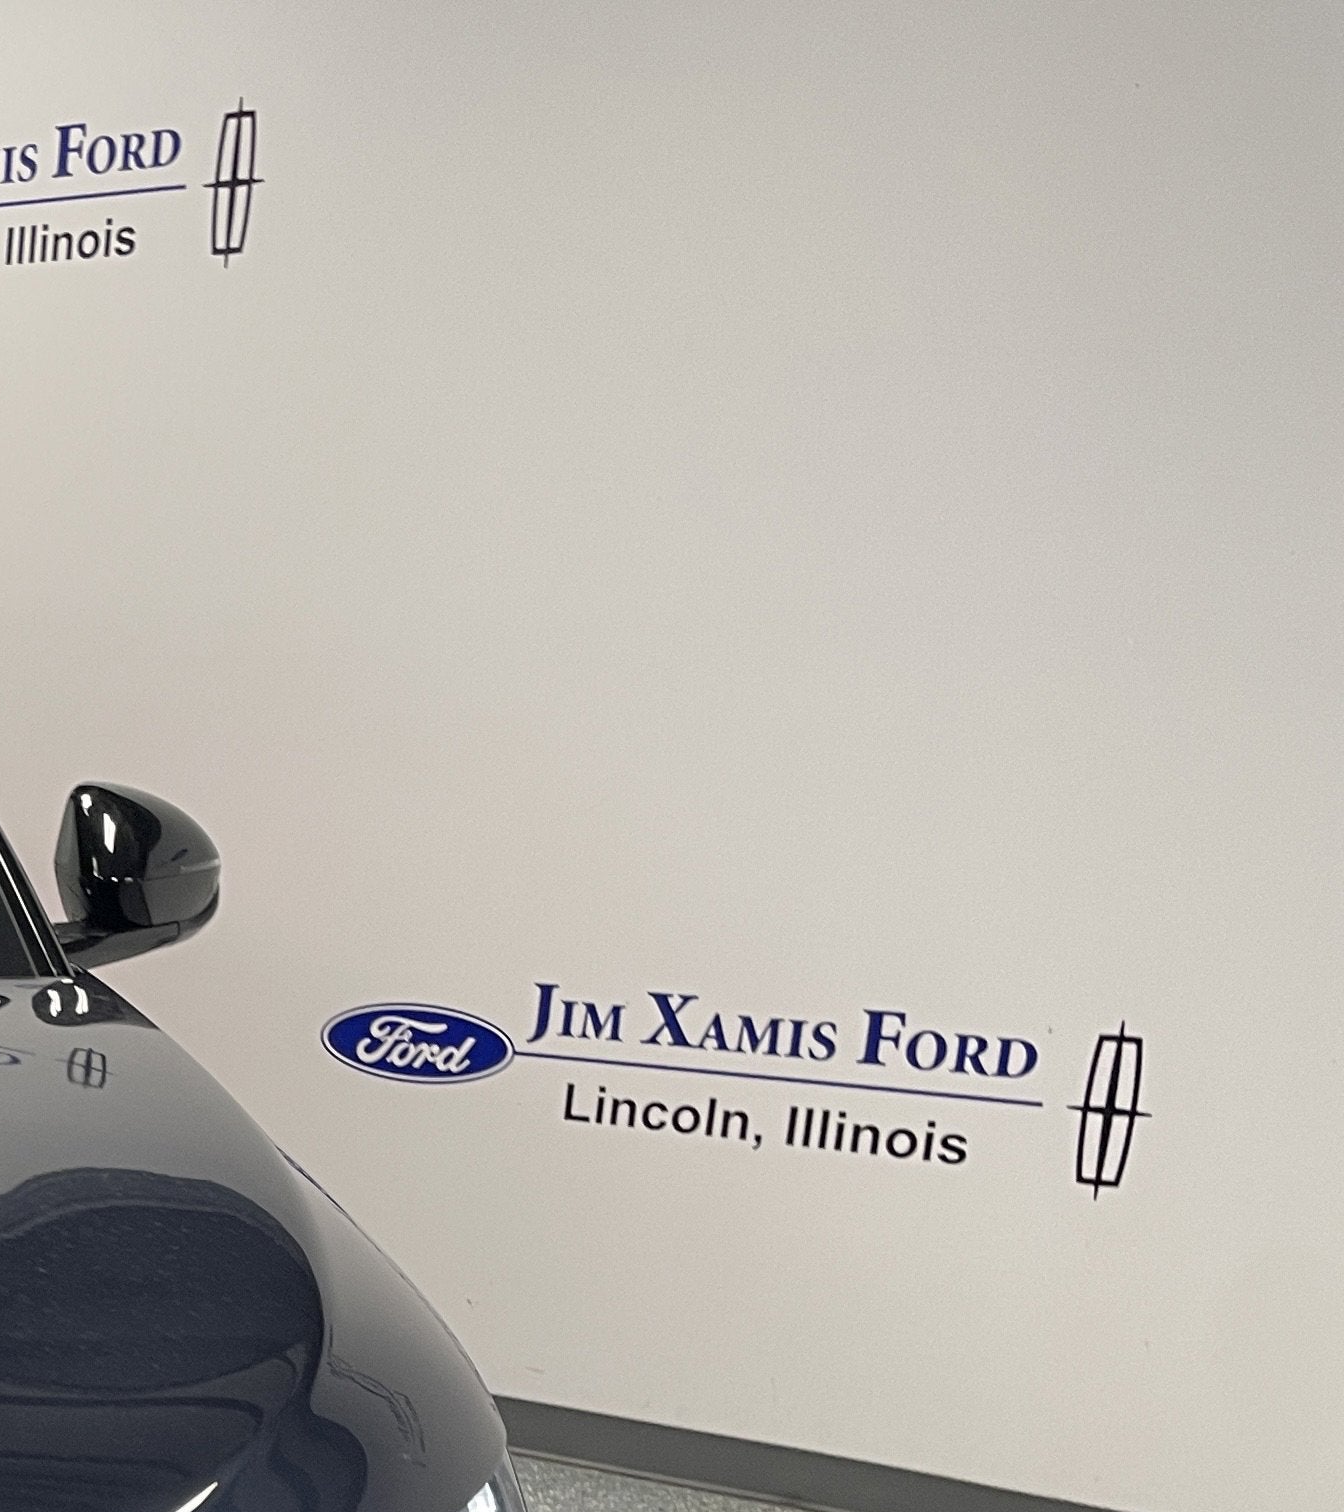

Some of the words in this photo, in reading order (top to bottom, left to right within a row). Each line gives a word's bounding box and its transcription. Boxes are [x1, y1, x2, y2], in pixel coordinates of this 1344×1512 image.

[51, 122, 181, 179] FORD
[4, 218, 136, 266] Illinois
[355, 1015, 472, 1073] Ford
[526, 982, 626, 1044] JIM
[640, 990, 839, 1063] XAMIS
[857, 1008, 1040, 1080] FORD
[563, 1083, 764, 1150] Lincoln,
[784, 1105, 969, 1167] Illinois
